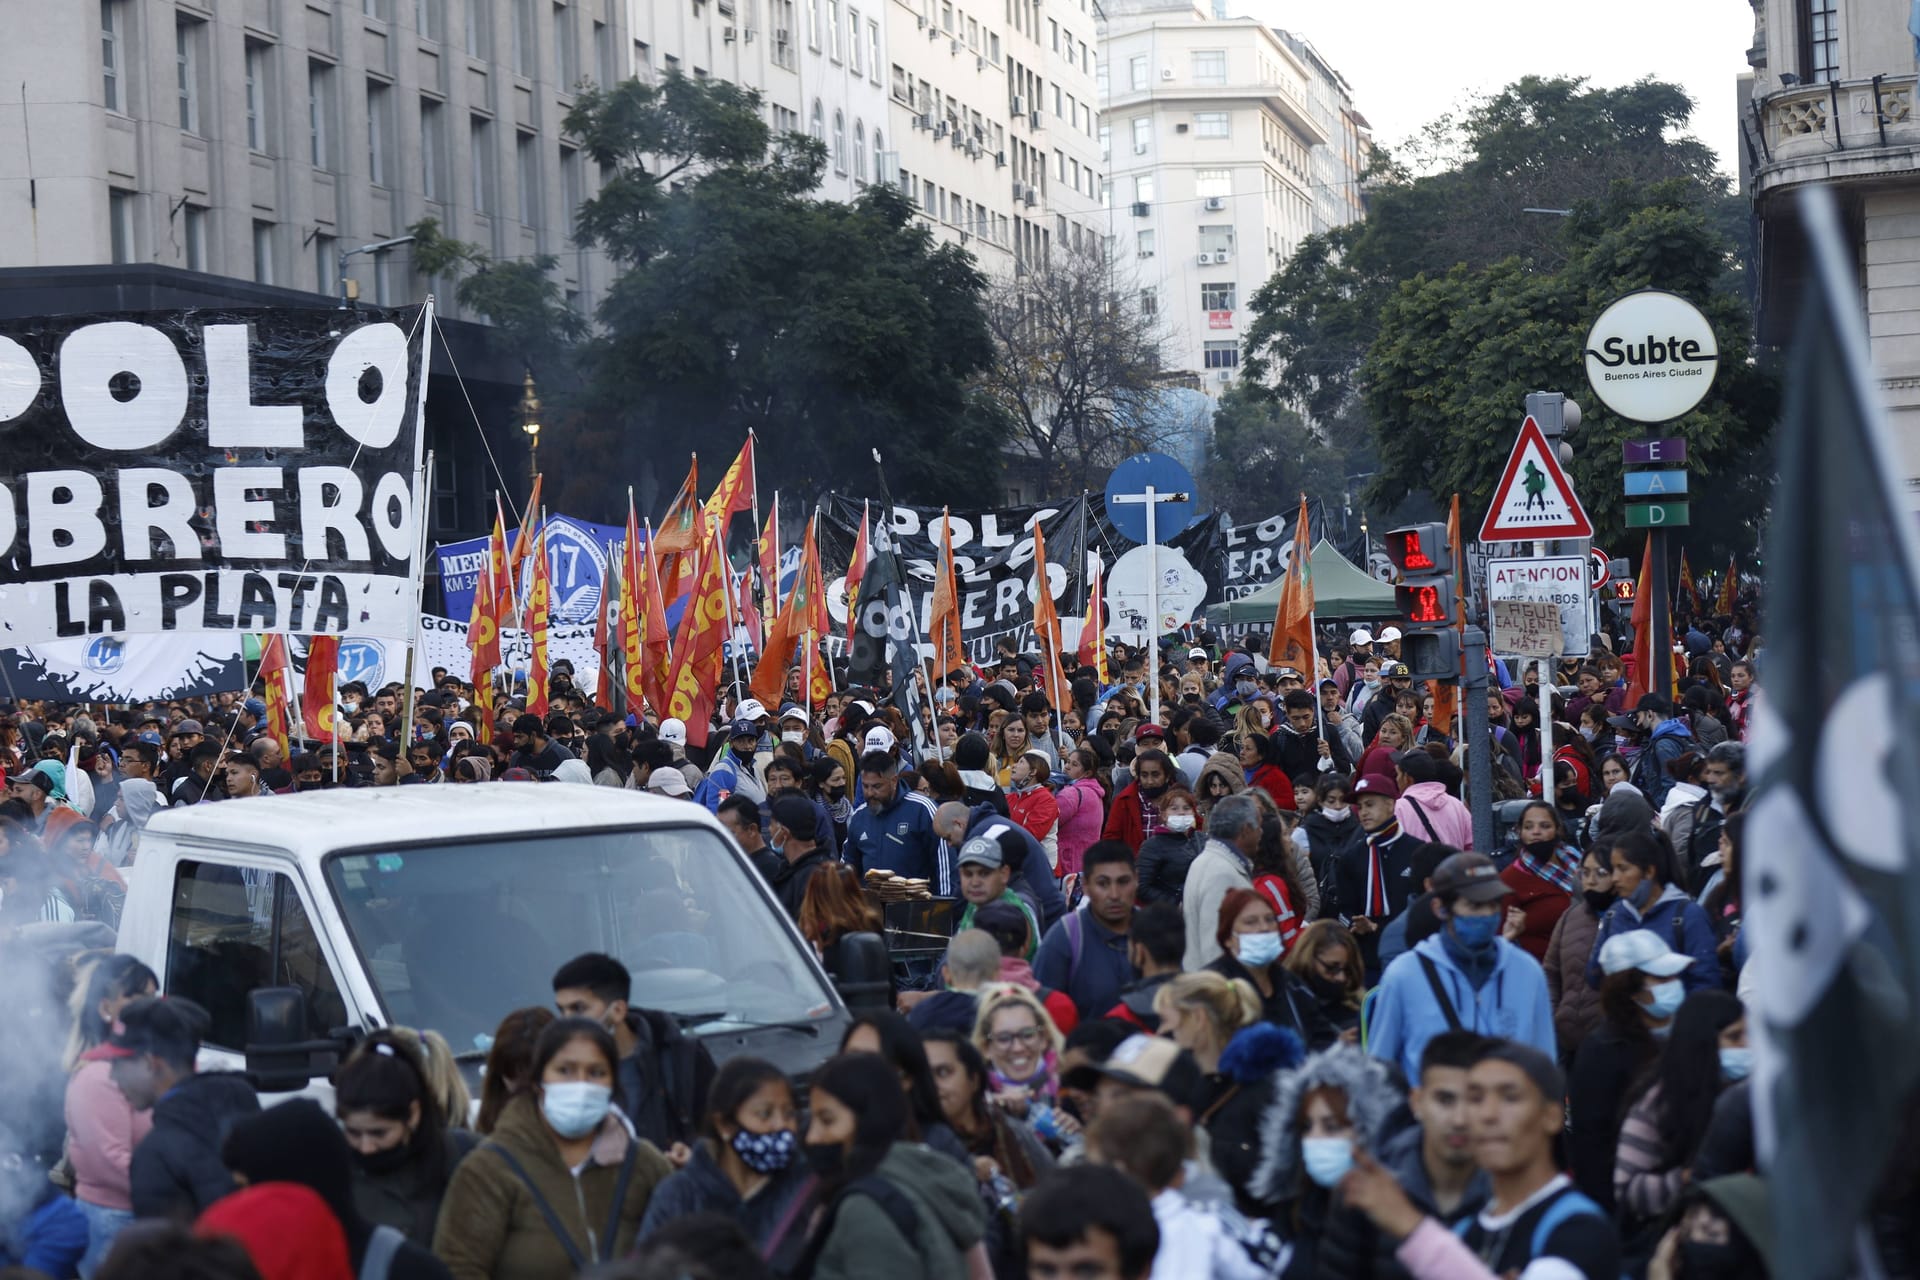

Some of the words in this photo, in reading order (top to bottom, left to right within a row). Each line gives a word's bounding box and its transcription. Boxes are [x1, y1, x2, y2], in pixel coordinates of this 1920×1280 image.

[1600, 335, 1704, 367] Subte
[1604, 371, 1640, 382] Buenos
[1642, 369, 1667, 379] Aires
[1669, 367, 1703, 378] Ciudad
[1649, 441, 1661, 460] E
[1647, 473, 1666, 493] A
[0, 466, 412, 567] BRERO
[1649, 505, 1666, 525] D
[548, 542, 580, 589] 17
[444, 576, 466, 593] KM
[54, 580, 127, 638] LA
[160, 571, 350, 633] PLATA
[1508, 603, 1557, 619] AGUA
[1510, 636, 1548, 650] MATE
[341, 646, 367, 673] 17
